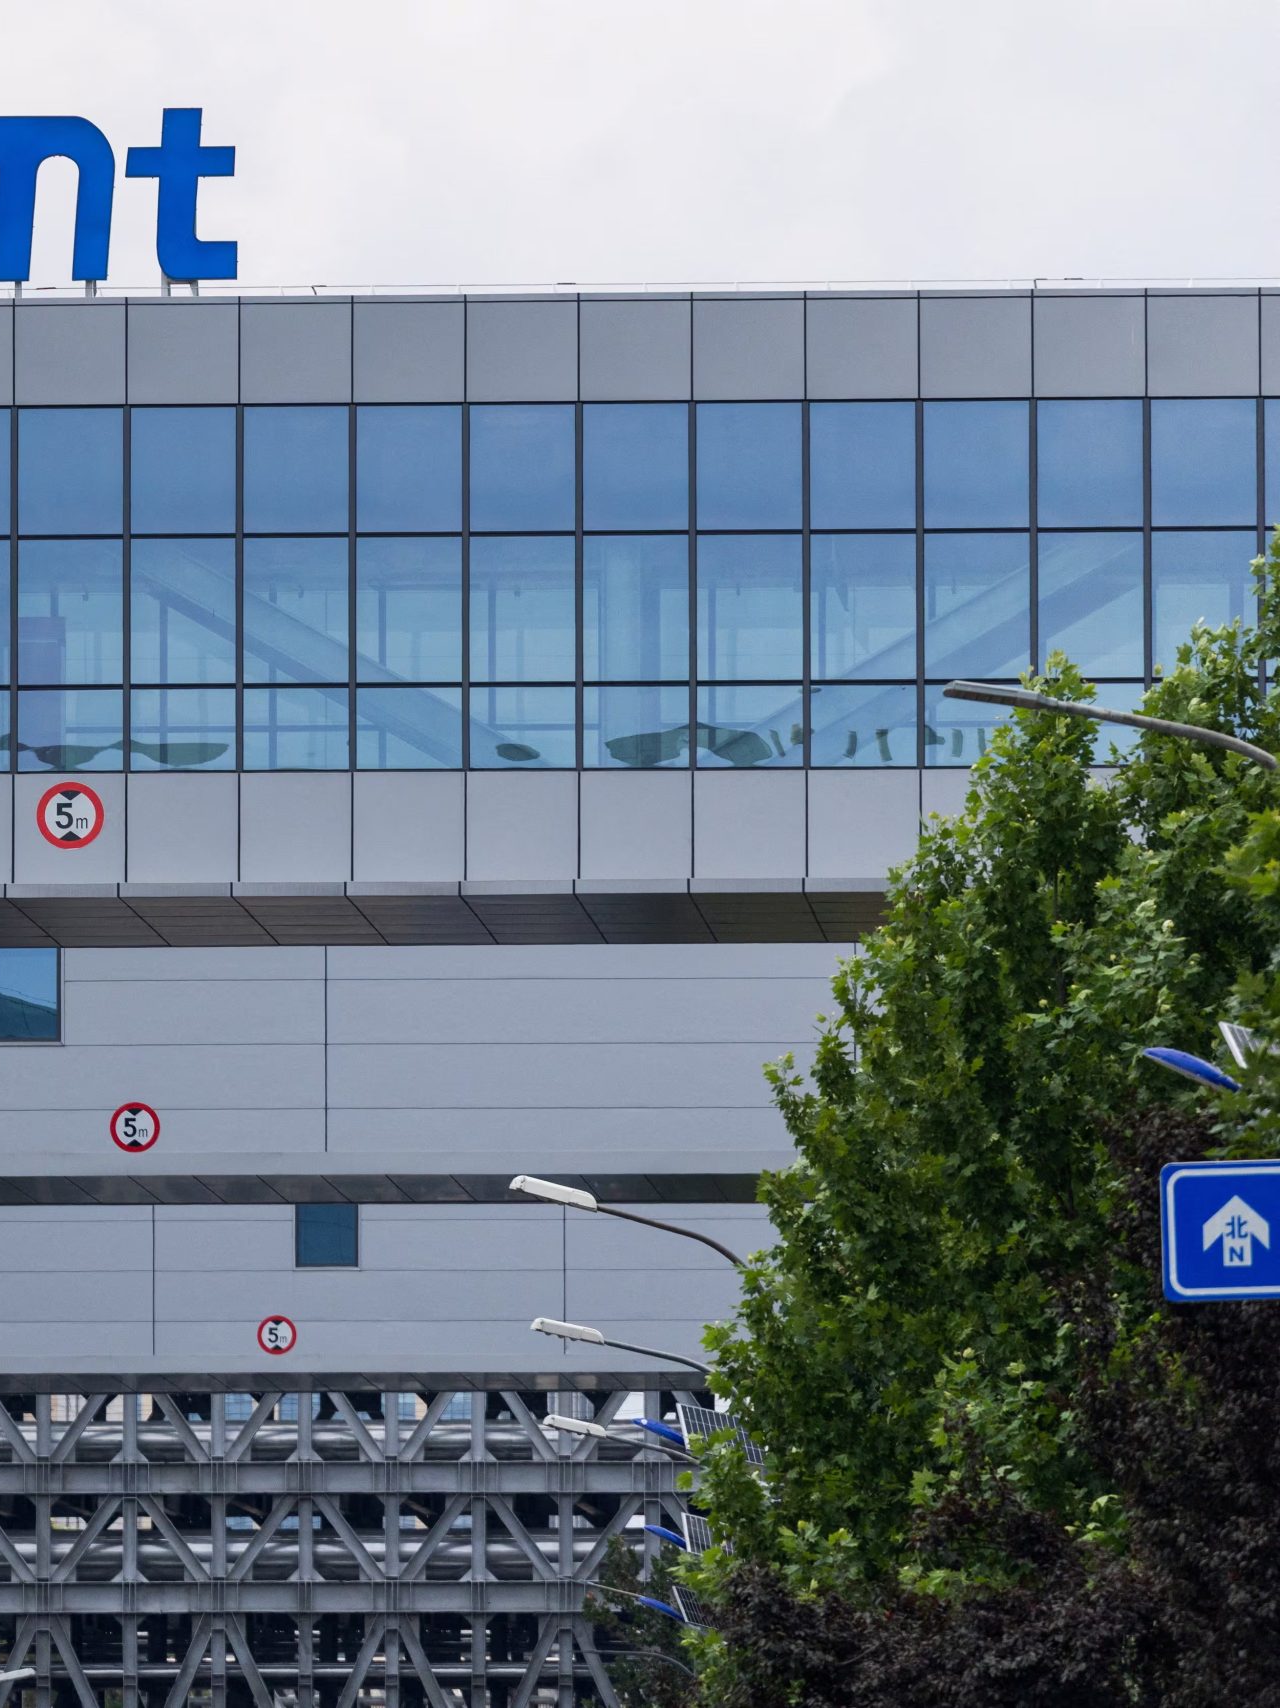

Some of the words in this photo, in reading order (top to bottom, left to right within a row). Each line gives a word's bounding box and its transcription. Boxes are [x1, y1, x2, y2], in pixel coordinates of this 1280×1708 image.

[55, 802, 88, 829] 5m
[123, 1117, 148, 1138] 5m
[1225, 1215, 1249, 1239] 北
[1229, 1246, 1244, 1262] N
